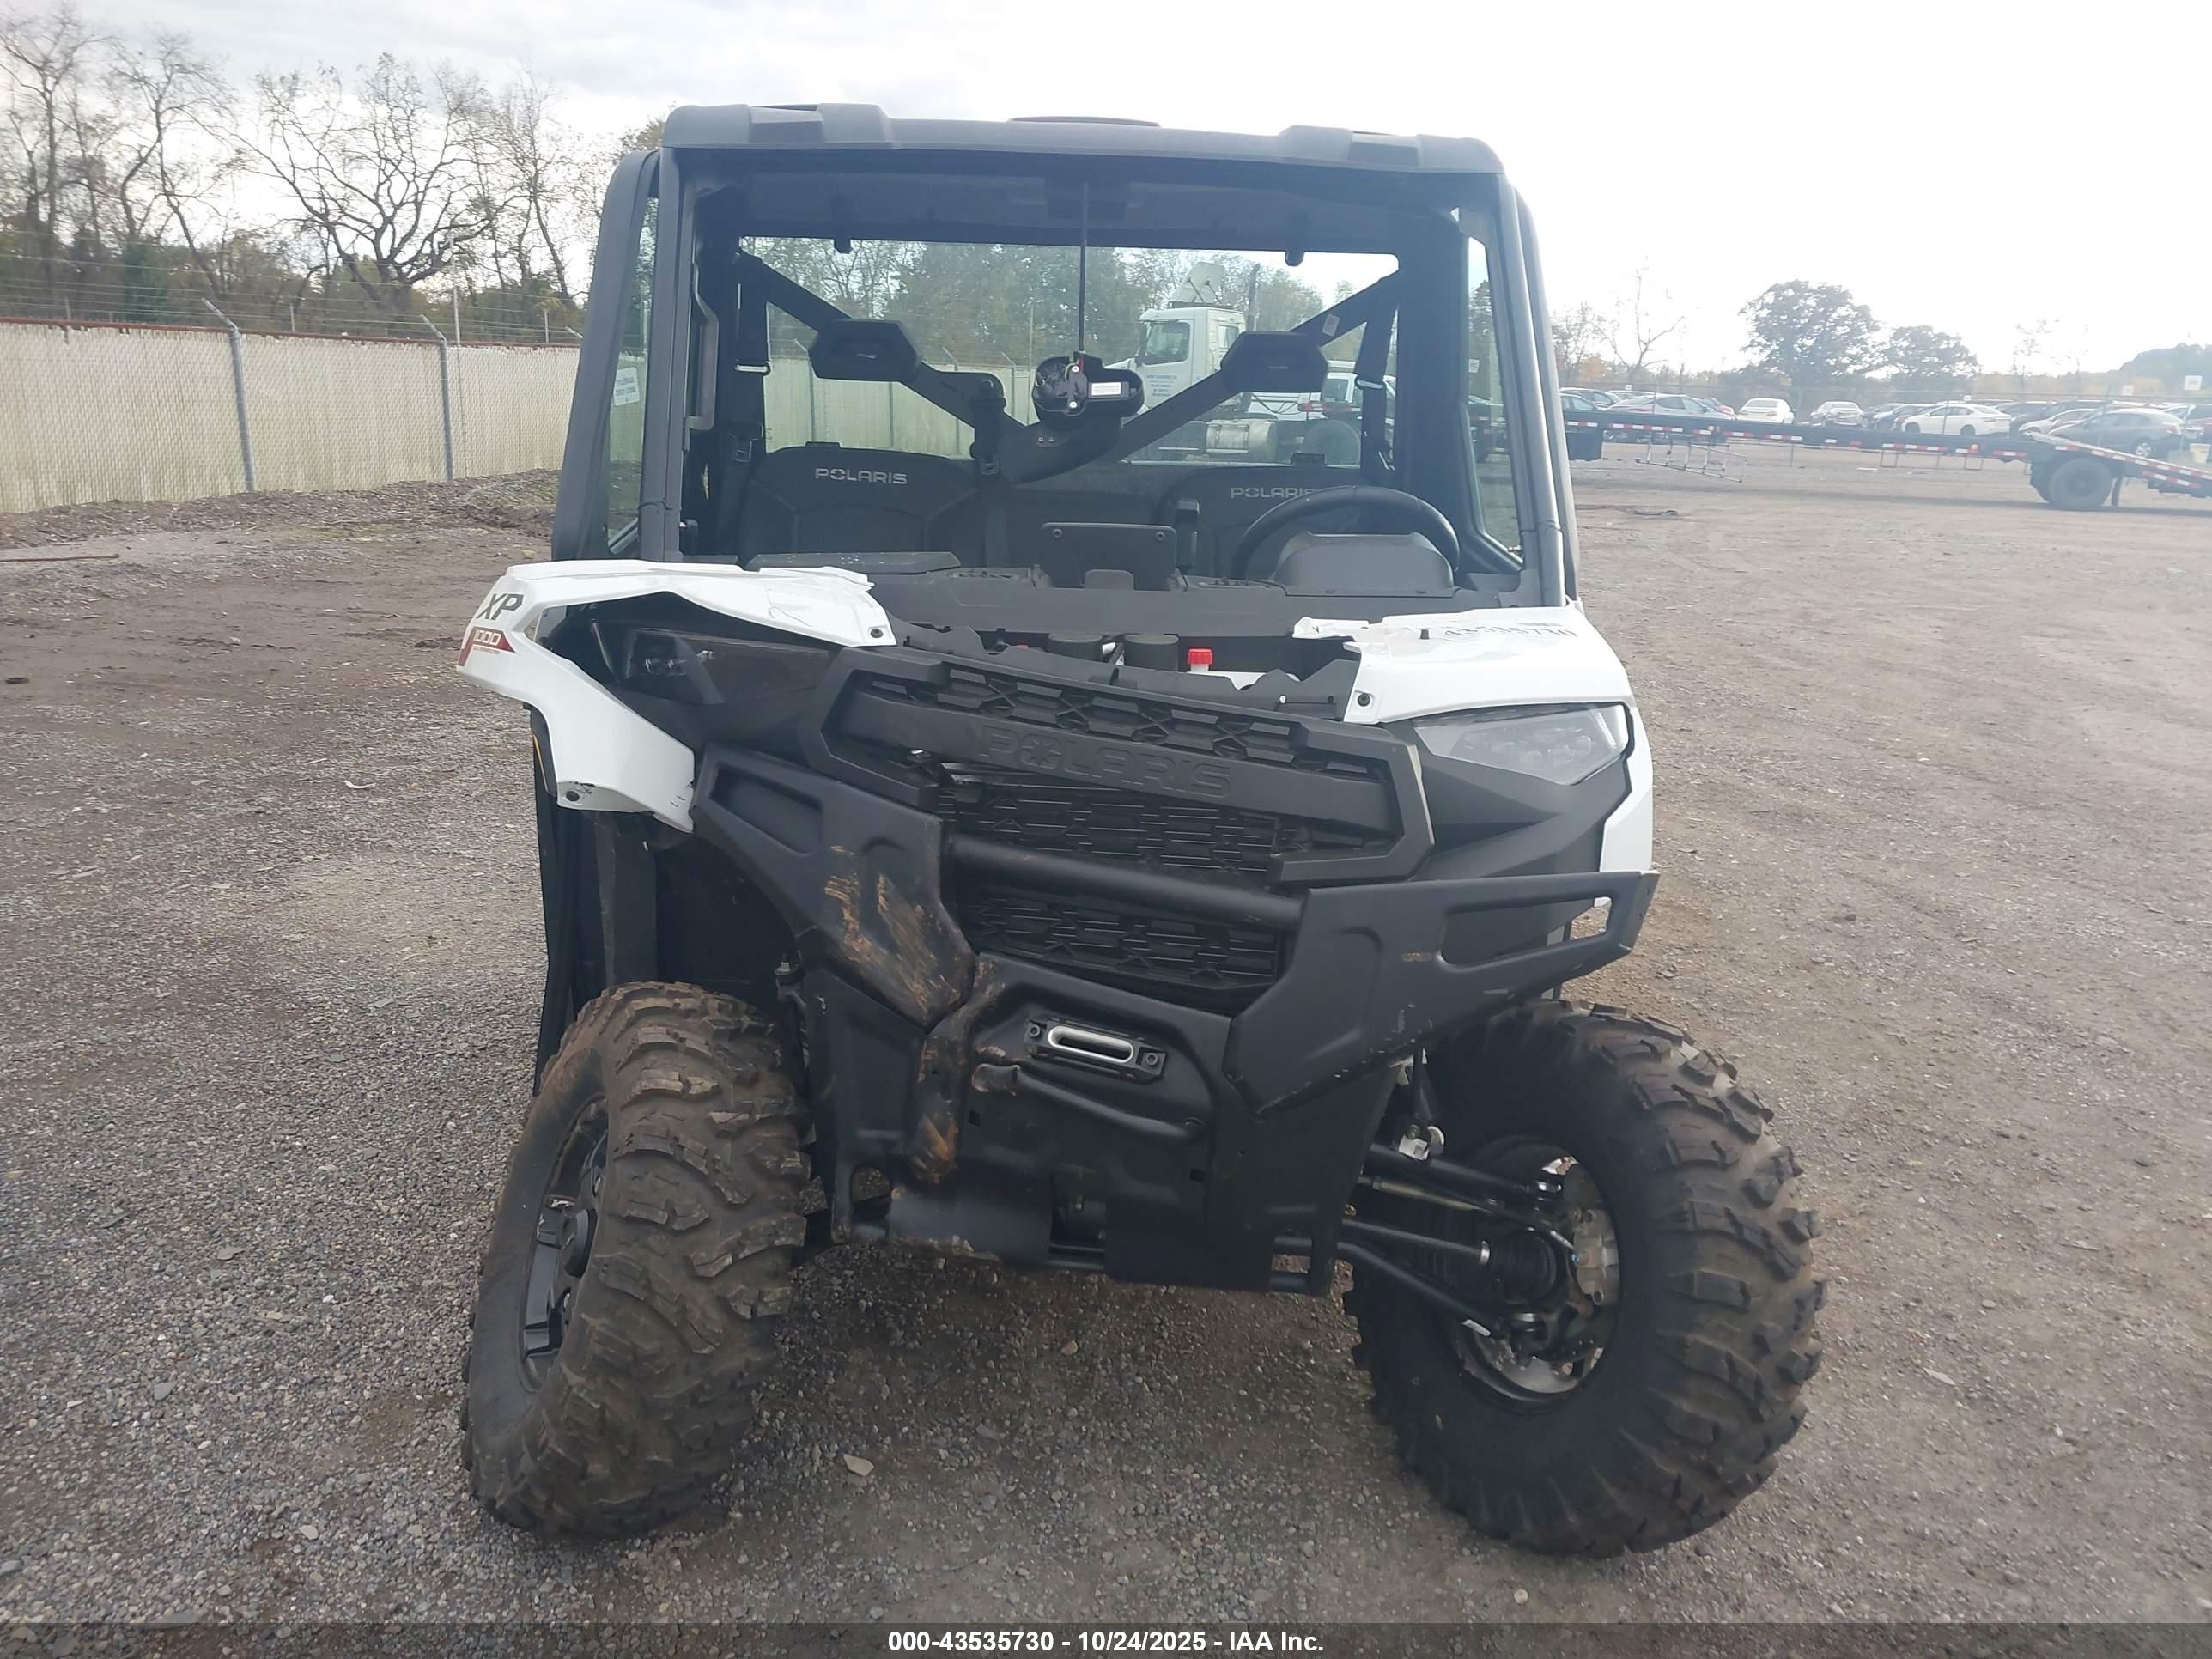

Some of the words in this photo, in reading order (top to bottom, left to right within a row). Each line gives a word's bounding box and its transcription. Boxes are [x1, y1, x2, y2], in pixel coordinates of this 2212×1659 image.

[815, 467, 908, 485] POLARIS
[476, 593, 524, 620] XP
[979, 725, 1231, 799] POLARIS
